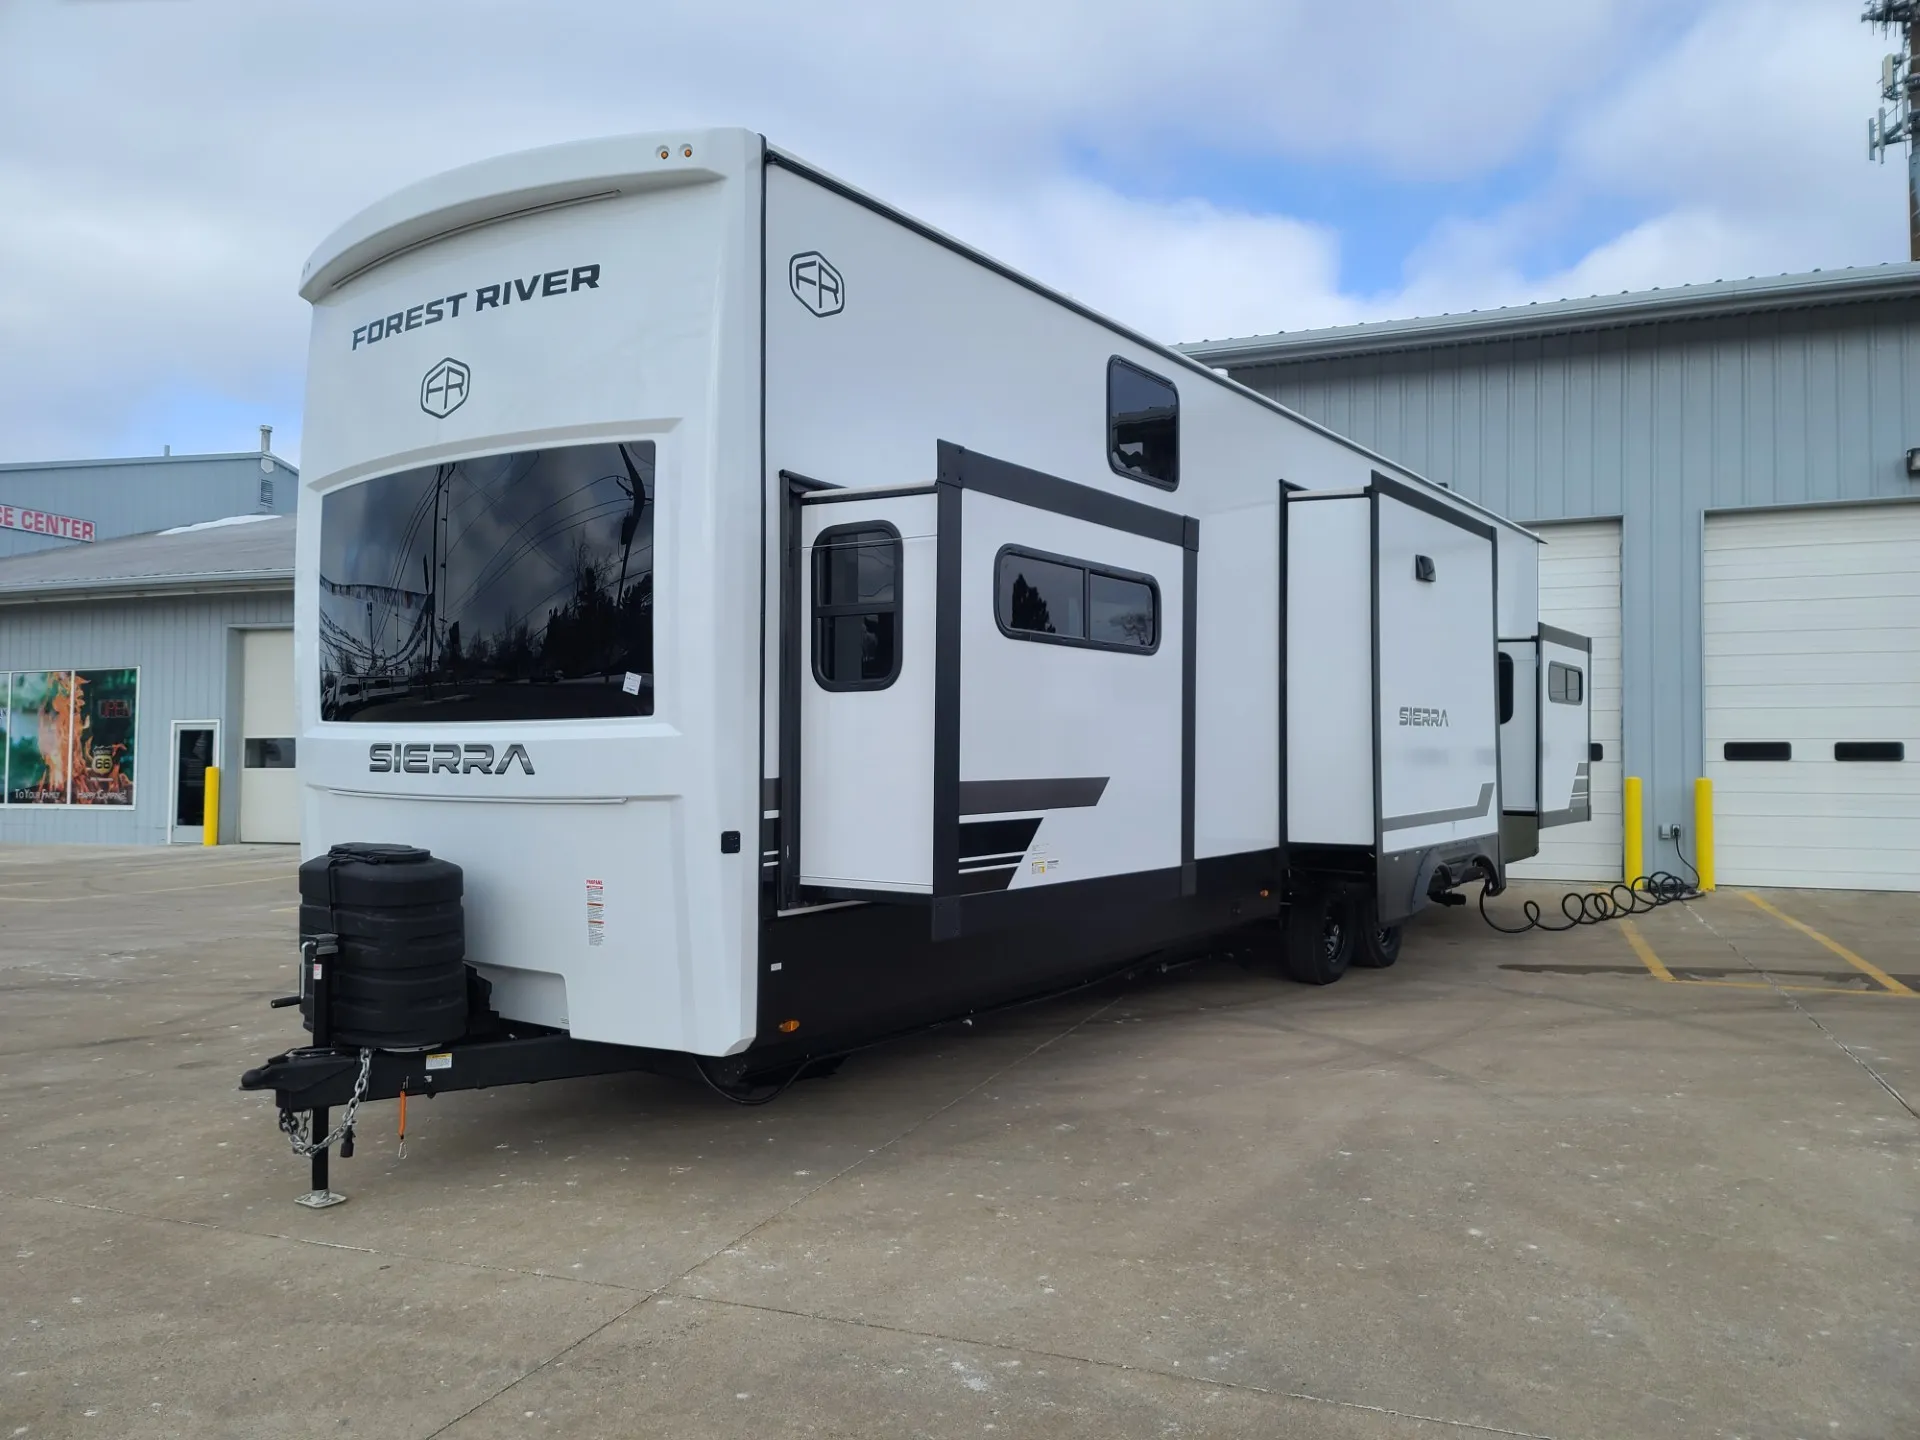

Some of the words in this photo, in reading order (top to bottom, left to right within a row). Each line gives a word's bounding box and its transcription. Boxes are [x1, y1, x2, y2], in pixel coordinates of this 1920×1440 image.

[352, 292, 467, 351] FOREST
[475, 264, 600, 312] RIVER
[0, 506, 14, 527] E
[21, 510, 94, 541] CENTER
[1399, 706, 1449, 727] SIERRA
[95, 758, 112, 769] 66
[369, 743, 536, 775] SIERRA
